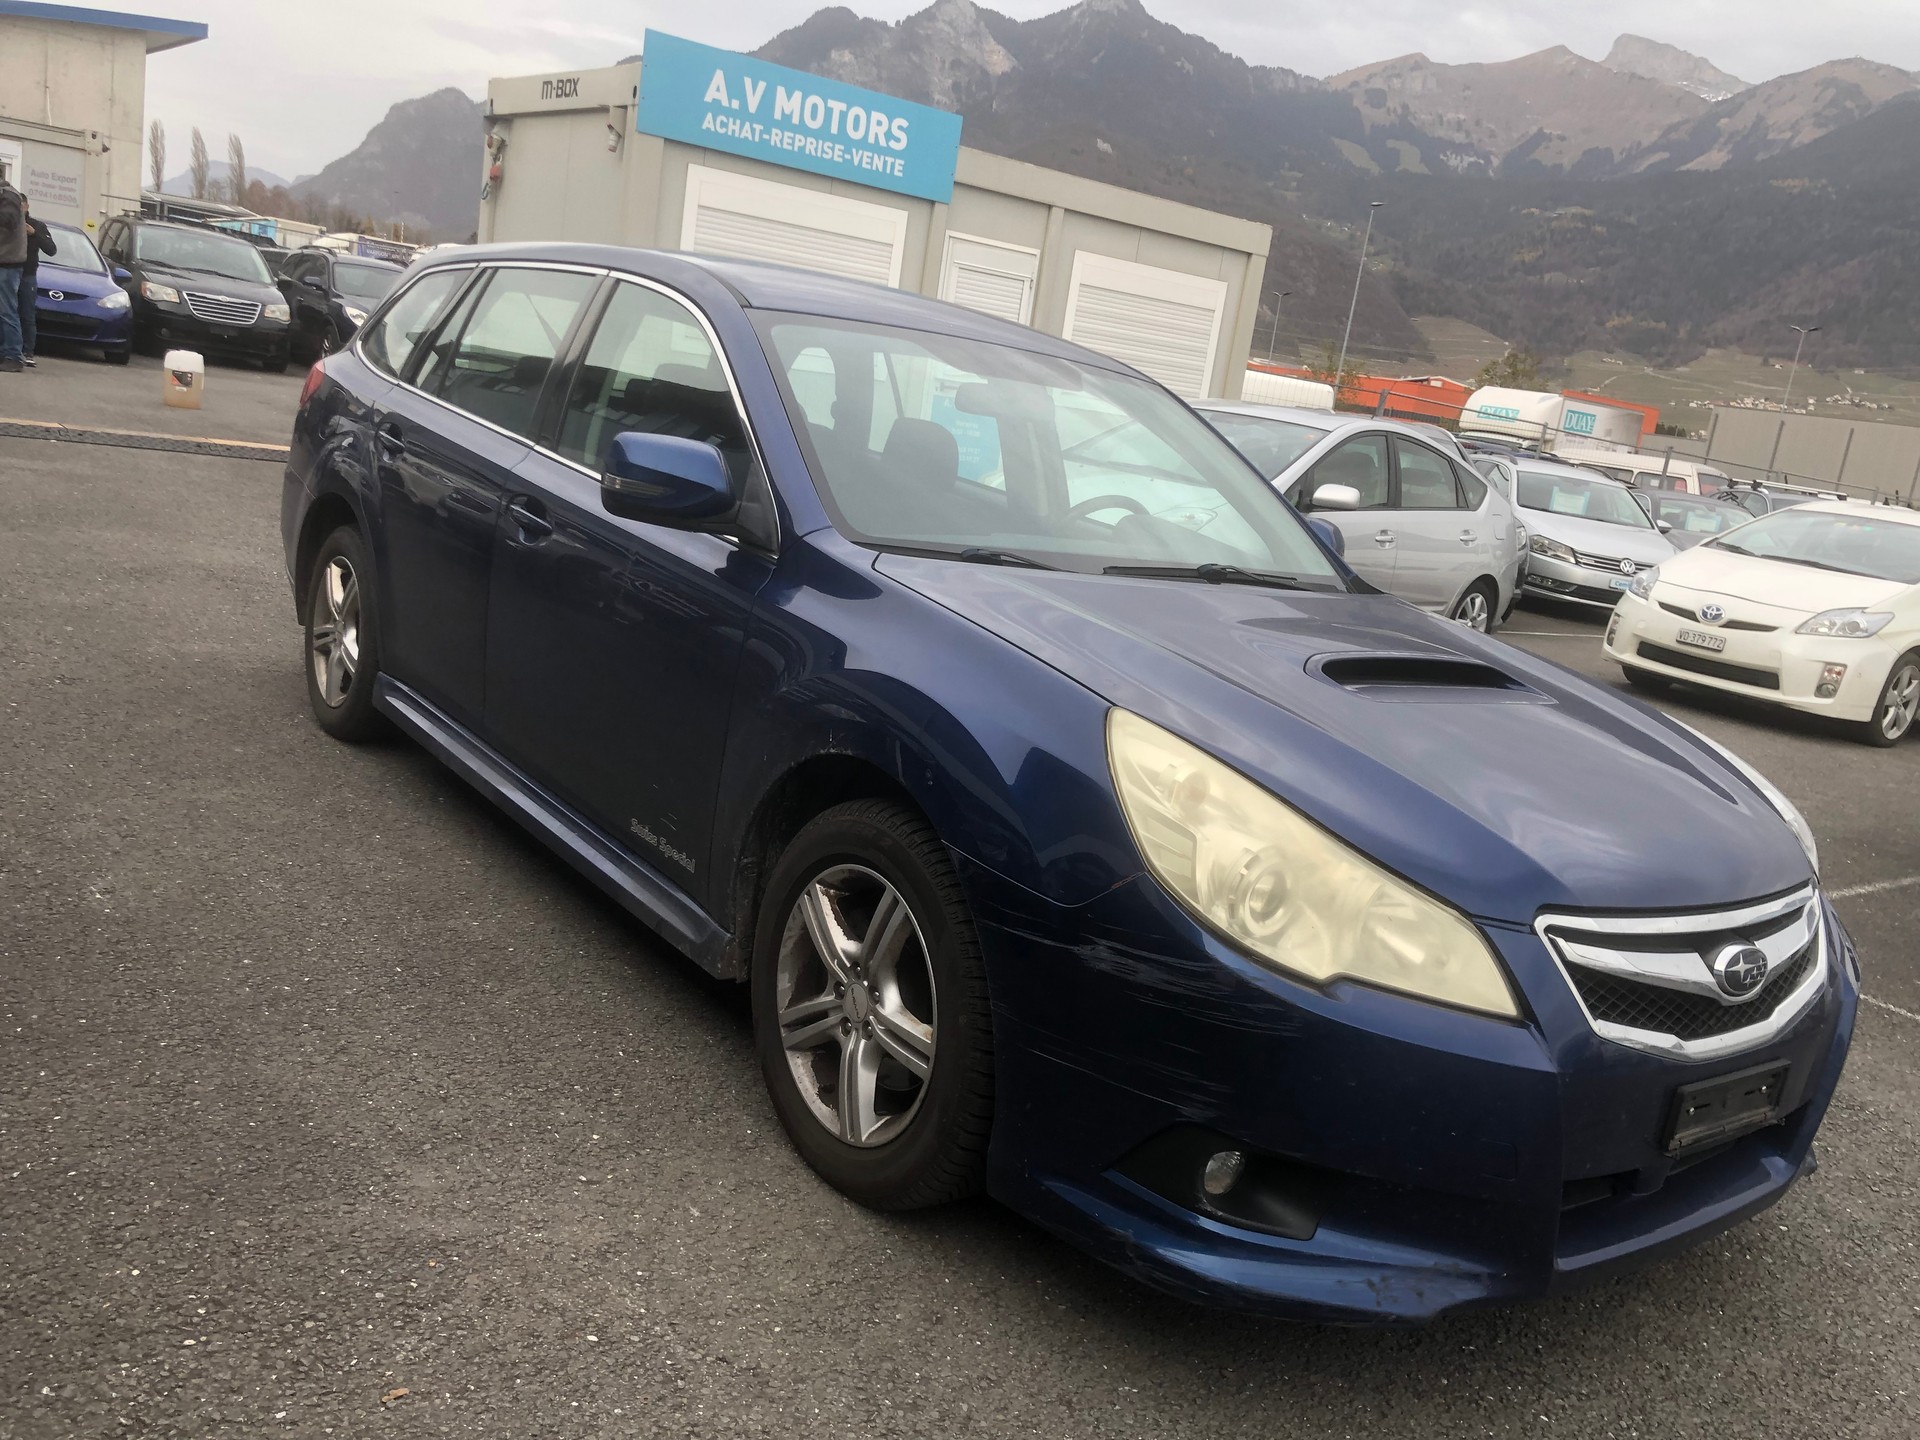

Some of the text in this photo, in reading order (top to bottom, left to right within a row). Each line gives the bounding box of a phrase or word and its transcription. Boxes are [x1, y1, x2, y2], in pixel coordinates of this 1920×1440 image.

[703, 68, 909, 151] A.V MOTORS
[702, 112, 905, 177] ACHAT-REPRISE-VENTE
[31, 168, 77, 184] Auto Export
[1478, 406, 1516, 420] DUAY
[1565, 412, 1595, 432] DUAY
[659, 837, 695, 874] Special
